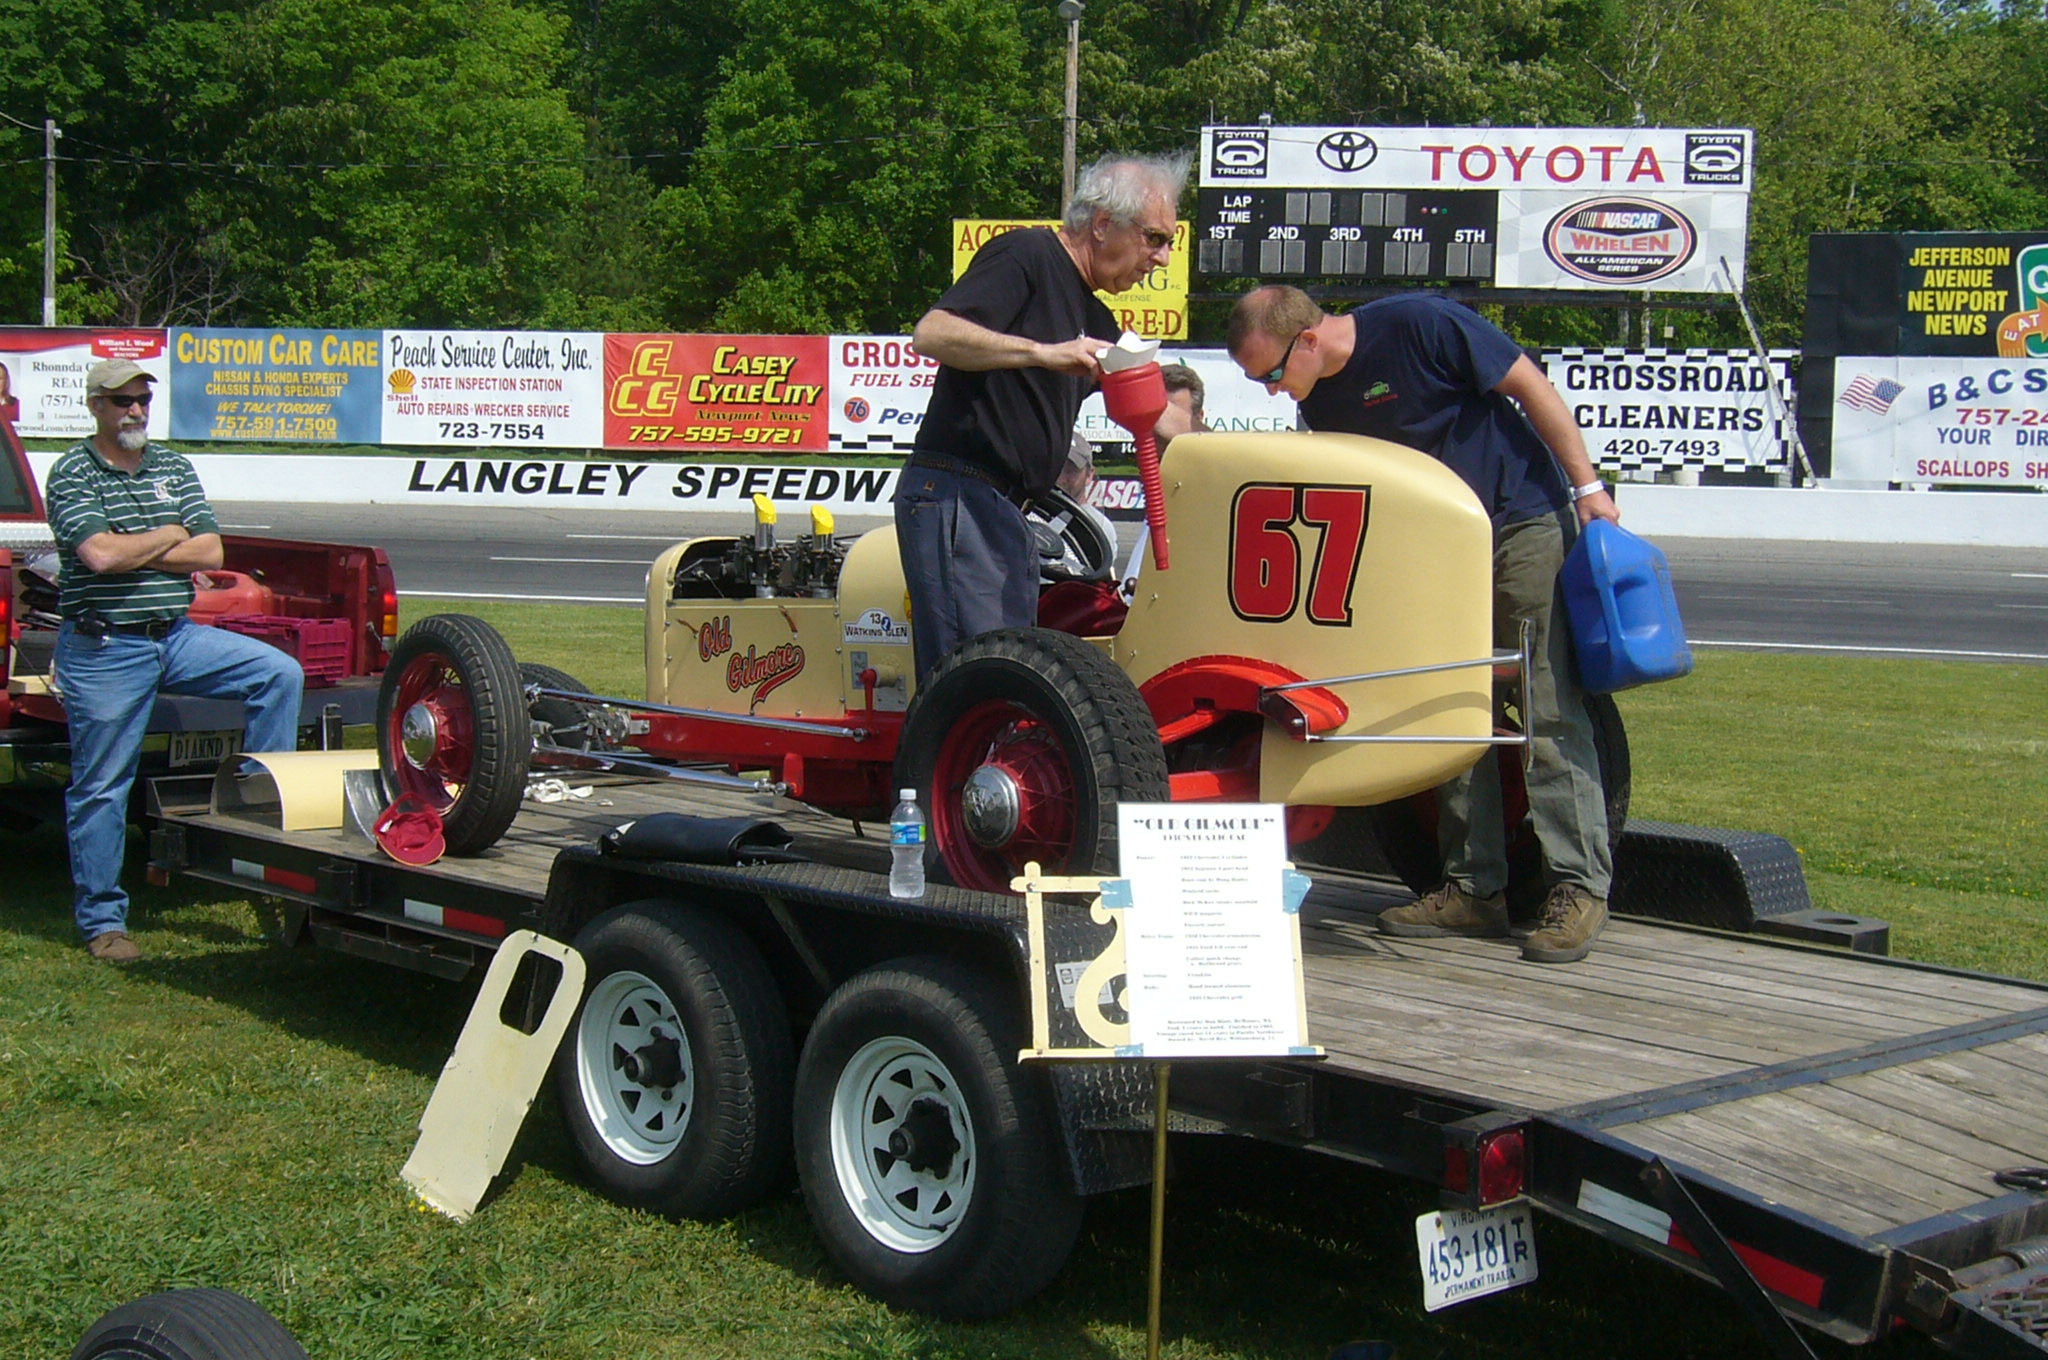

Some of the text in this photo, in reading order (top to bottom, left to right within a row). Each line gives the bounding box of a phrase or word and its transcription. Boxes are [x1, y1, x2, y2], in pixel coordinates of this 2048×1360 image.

[1217, 131, 1265, 139] TOYOTA
[1690, 136, 1741, 144] TOYOTA
[1216, 167, 1264, 175] TRUCKS
[1420, 145, 1665, 183] TOYOTA
[1223, 196, 1252, 208] LAP
[1218, 211, 1251, 223] TIME
[1603, 212, 1662, 229] NASCAR
[1208, 226, 1486, 243] 1ST 2ND 3RD 4TH 5TH
[1570, 232, 1670, 252] WHELEN
[1574, 256, 1664, 265] ALL-AMERICAN
[1909, 247, 2010, 267] JEFFERSON
[1923, 269, 1993, 288] AVENUE
[1907, 290, 2008, 312] NEWPORT
[1925, 314, 1987, 336] NEWS
[2003, 313, 2041, 342] EAT
[177, 332, 379, 367] CUSTOM CAR CARE
[390, 334, 592, 372] Peach Service Center, Inc.
[32, 361, 82, 372] Rhonnda
[712, 346, 797, 376] CASEY
[213, 370, 348, 385] NISSAN & HONDA EXPERTS
[421, 377, 562, 392] STATE INSPECTION STATION
[850, 374, 902, 387] FUEL
[1566, 364, 1769, 392] CROSSROAD
[206, 384, 343, 397] CHASSIS DYNO SPECIALIST
[386, 394, 418, 402] Shell
[1928, 382, 1948, 410] B
[1955, 376, 1981, 401] &
[1988, 368, 2014, 394] C
[41, 394, 73, 408] (757)
[217, 402, 332, 414] WE TALK TORQUE!
[397, 402, 570, 418] AUTO REPAIRS WRECKER SERVICE
[847, 401, 867, 418] 76
[696, 409, 811, 424] Newport News
[1574, 404, 1764, 432] CLEANERS
[439, 422, 545, 440] 723-7554
[628, 426, 803, 444] 757-595-9721
[1937, 428, 1991, 446] YOUR
[1604, 438, 1721, 456] 420-7493
[1916, 460, 2010, 478] SCALLOPS
[408, 460, 895, 503] LANGLEY SPEEDW
[1227, 480, 1372, 628] 67
[698, 615, 732, 662] Old
[845, 626, 908, 637] WATKINS GLEN
[726, 643, 805, 693] Gilmore
[1429, 1222, 1511, 1285] 453-181
